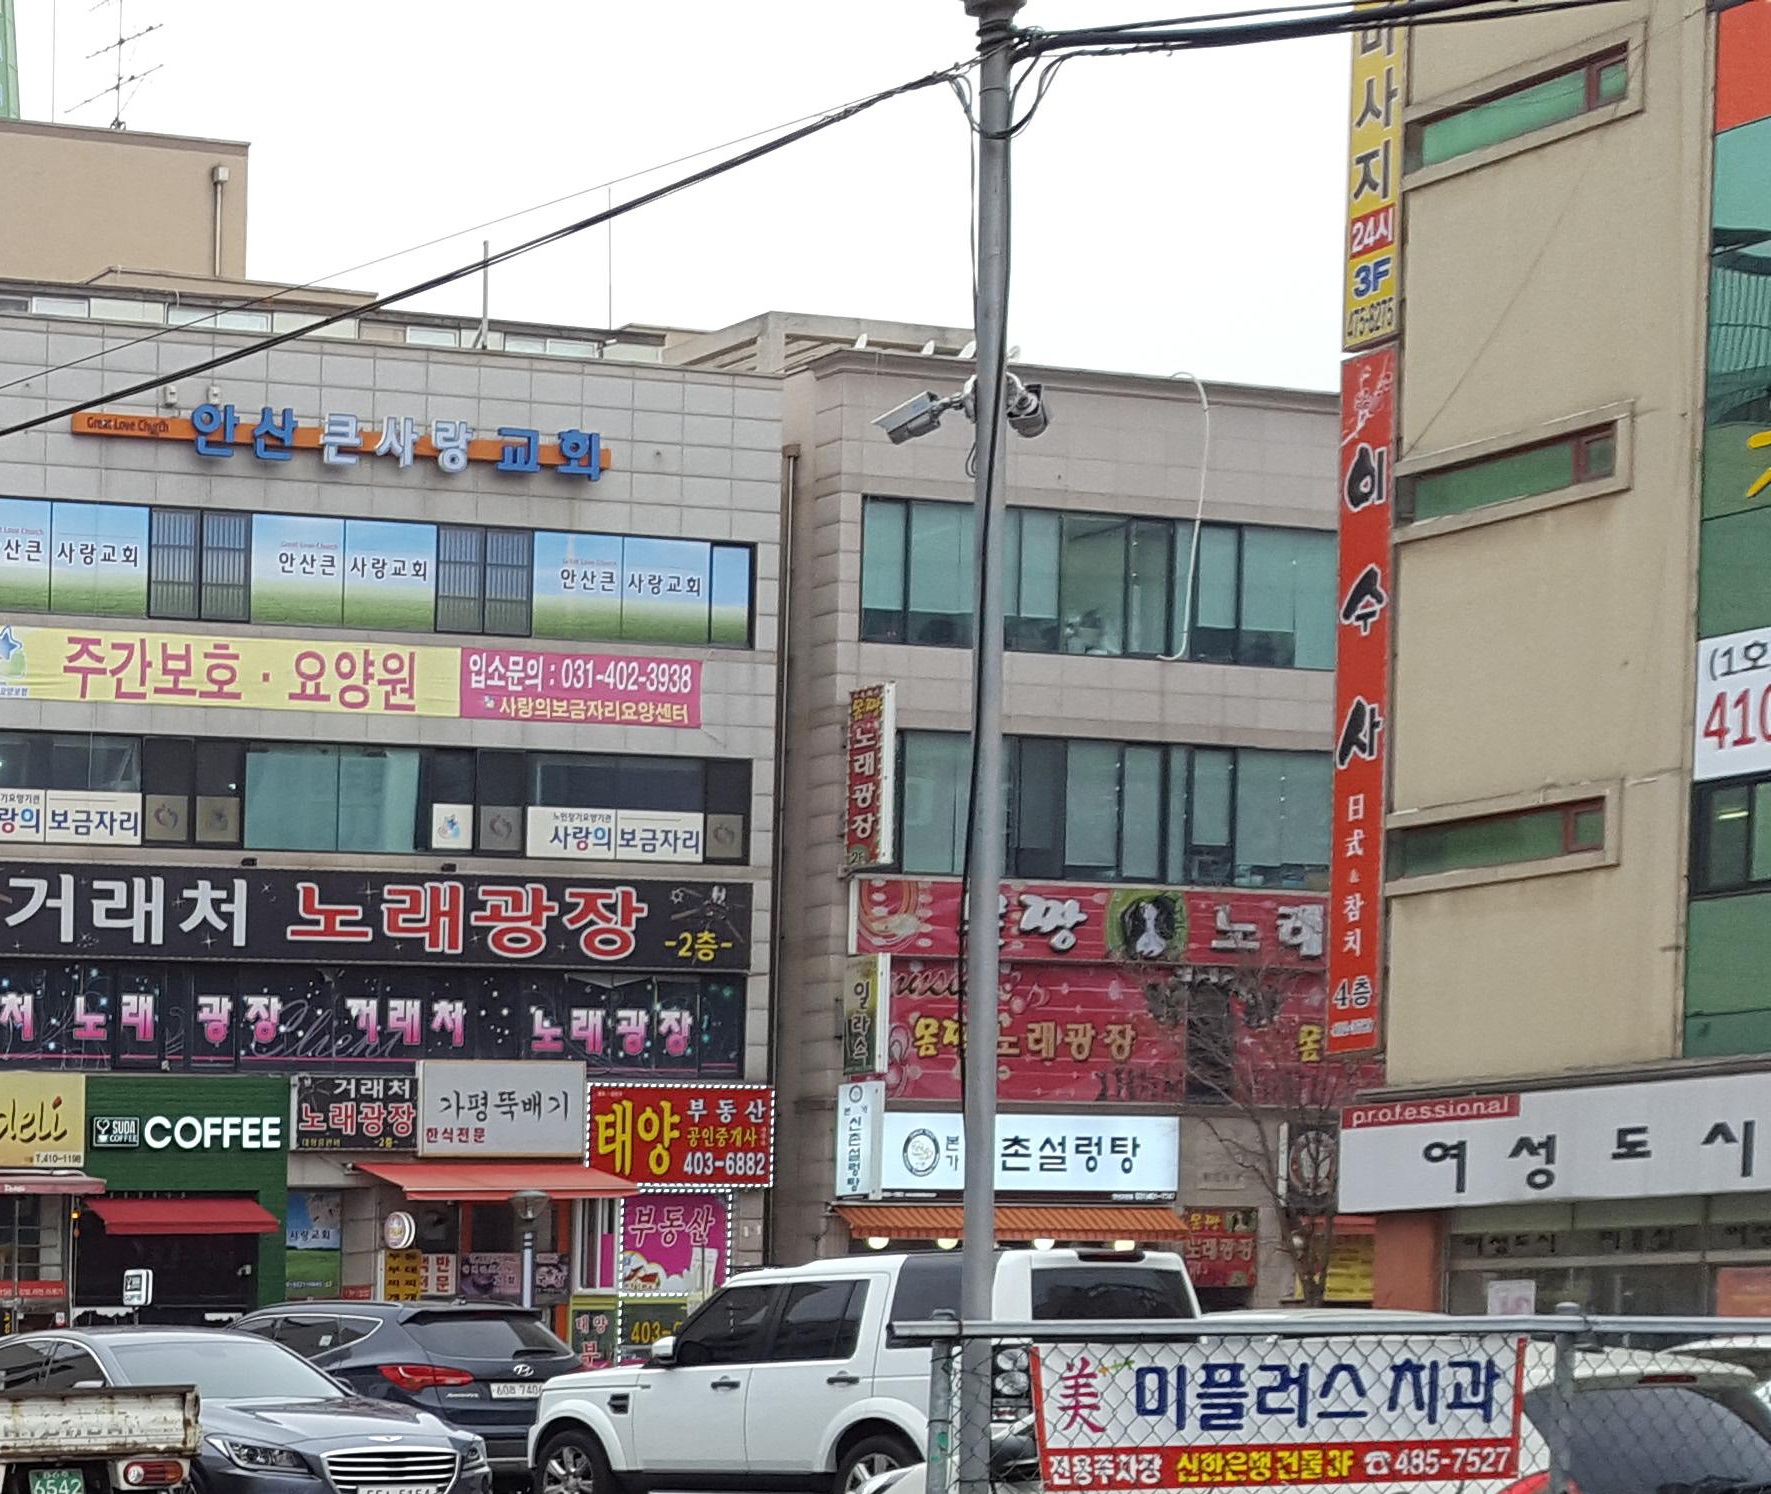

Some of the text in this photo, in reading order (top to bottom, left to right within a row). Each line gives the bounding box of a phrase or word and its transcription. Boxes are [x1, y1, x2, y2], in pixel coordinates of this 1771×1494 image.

[1354, 256, 1391, 299] 3F
[113, 418, 135, 431] Love
[191, 404, 601, 481] 안산 큰사랑 교회
[57, 543, 139, 568] 사랑교회
[350, 555, 428, 582] 사랑교회
[628, 572, 702, 597] 사랑교회
[62, 635, 417, 713] 주간보호 요양원
[469, 653, 692, 693] 입소문의 031-402-3938
[851, 728, 876, 839] 노래광장
[49, 810, 138, 837] 보금자리
[549, 826, 700, 854] 사랑의 보금자리
[4, 872, 248, 947] 거래처
[286, 881, 648, 961] 노래광장
[1343, 893, 1365, 957] 참치
[1332, 976, 1372, 1009] 4층
[74, 994, 282, 1043] 노래 광장
[531, 1007, 692, 1056] 노래광장
[333, 1079, 411, 1100] 거래처
[298, 1102, 416, 1137] 노래광장
[439, 1090, 571, 1124] 가평뚝배기
[1351, 1096, 1510, 1128] professional
[109, 1134, 139, 1143] COFFEE
[112, 1121, 136, 1134] SUDA
[144, 1116, 282, 1149] COFFEE
[426, 1127, 486, 1144] 한식전문
[594, 1099, 766, 1177] 태양 부동산
[686, 1127, 757, 1148] 공인중개사
[683, 1151, 766, 1177] 403-6882
[1001, 1135, 1141, 1174] 촌설렁탕
[1422, 1119, 1757, 1194] 여성도시
[628, 1205, 716, 1248] 부동산
[1058, 1356, 1106, 1436] 美
[1134, 1358, 1501, 1432] 미플러스 치과
[1393, 1446, 1511, 1477] 485-7527
